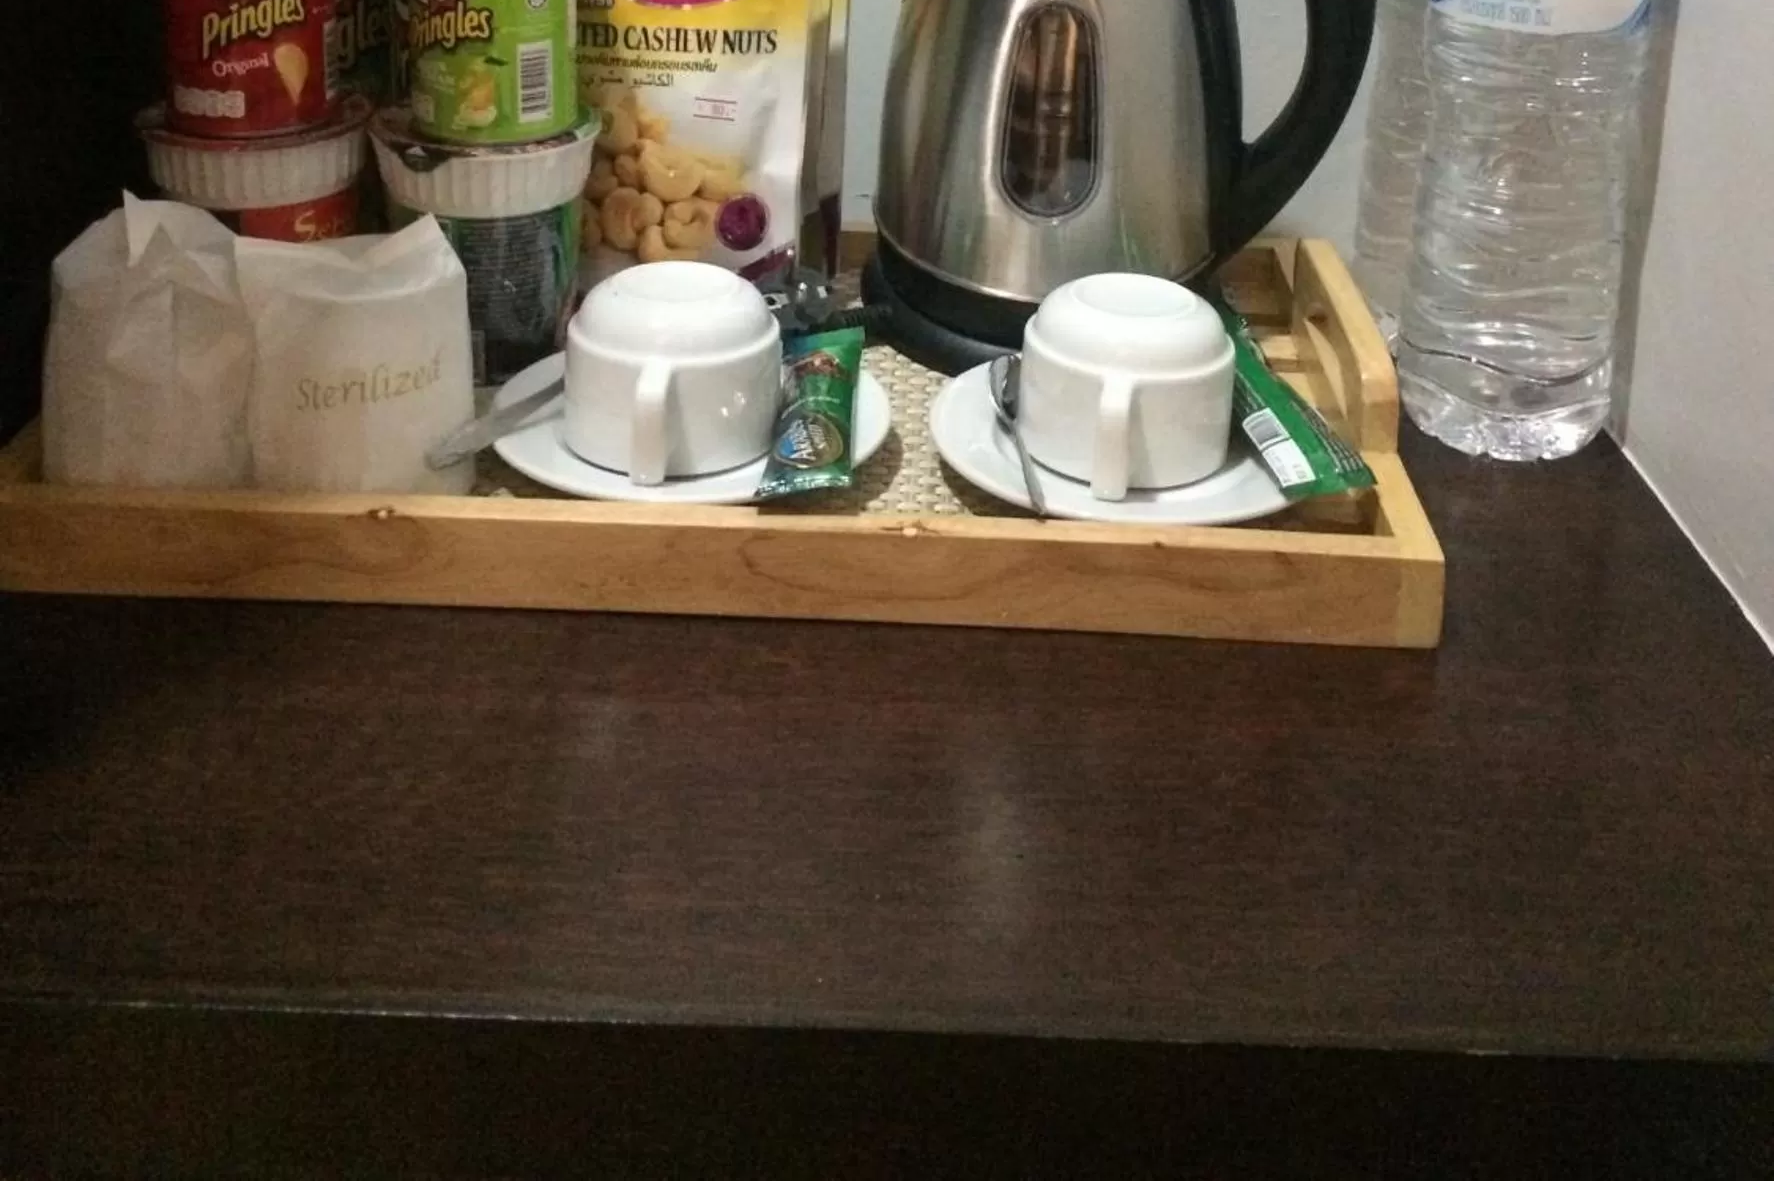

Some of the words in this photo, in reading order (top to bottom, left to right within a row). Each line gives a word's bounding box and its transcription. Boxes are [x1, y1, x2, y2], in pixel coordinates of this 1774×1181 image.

[577, 21, 618, 48] TED
[623, 24, 717, 54] CASHEW
[721, 28, 778, 55] NUTS
[297, 347, 445, 410] Sterilized
